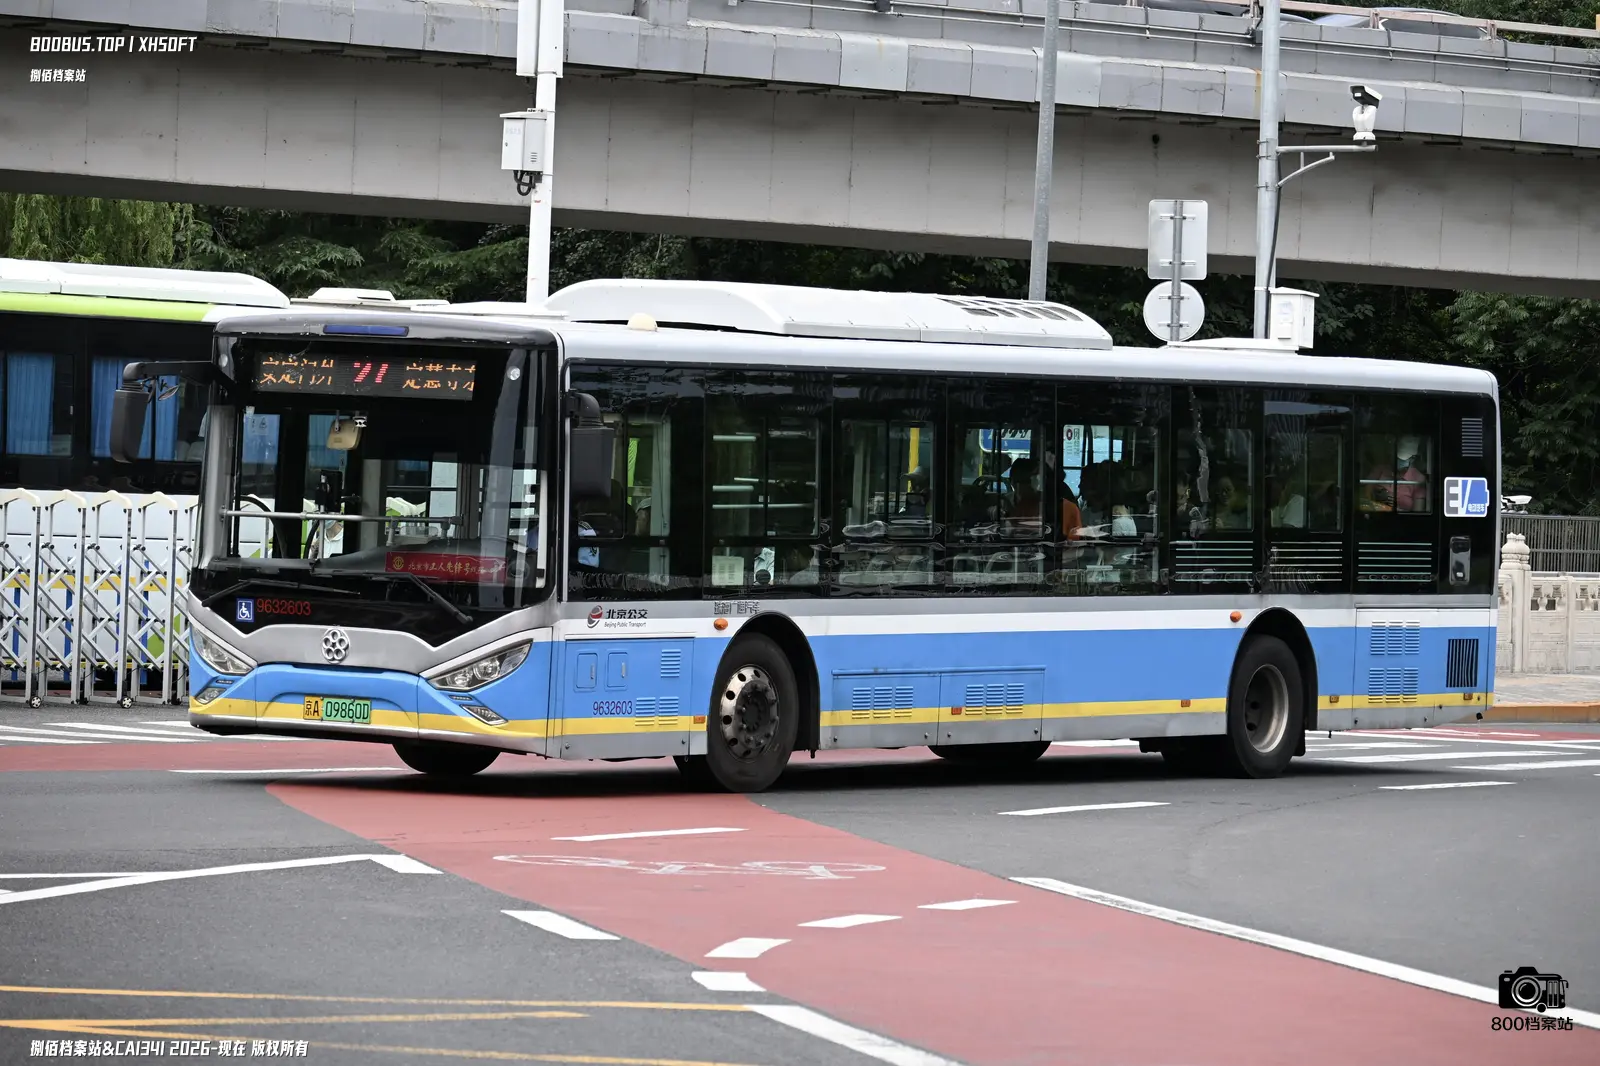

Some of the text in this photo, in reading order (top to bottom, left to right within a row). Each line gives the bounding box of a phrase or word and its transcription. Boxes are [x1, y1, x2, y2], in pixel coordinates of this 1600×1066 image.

[256, 599, 311, 616] 9632603
[606, 608, 649, 619] 北京公交
[604, 621, 617, 629] Beijing
[305, 700, 369, 720] 京A 09860D
[593, 701, 633, 716] 9632603
